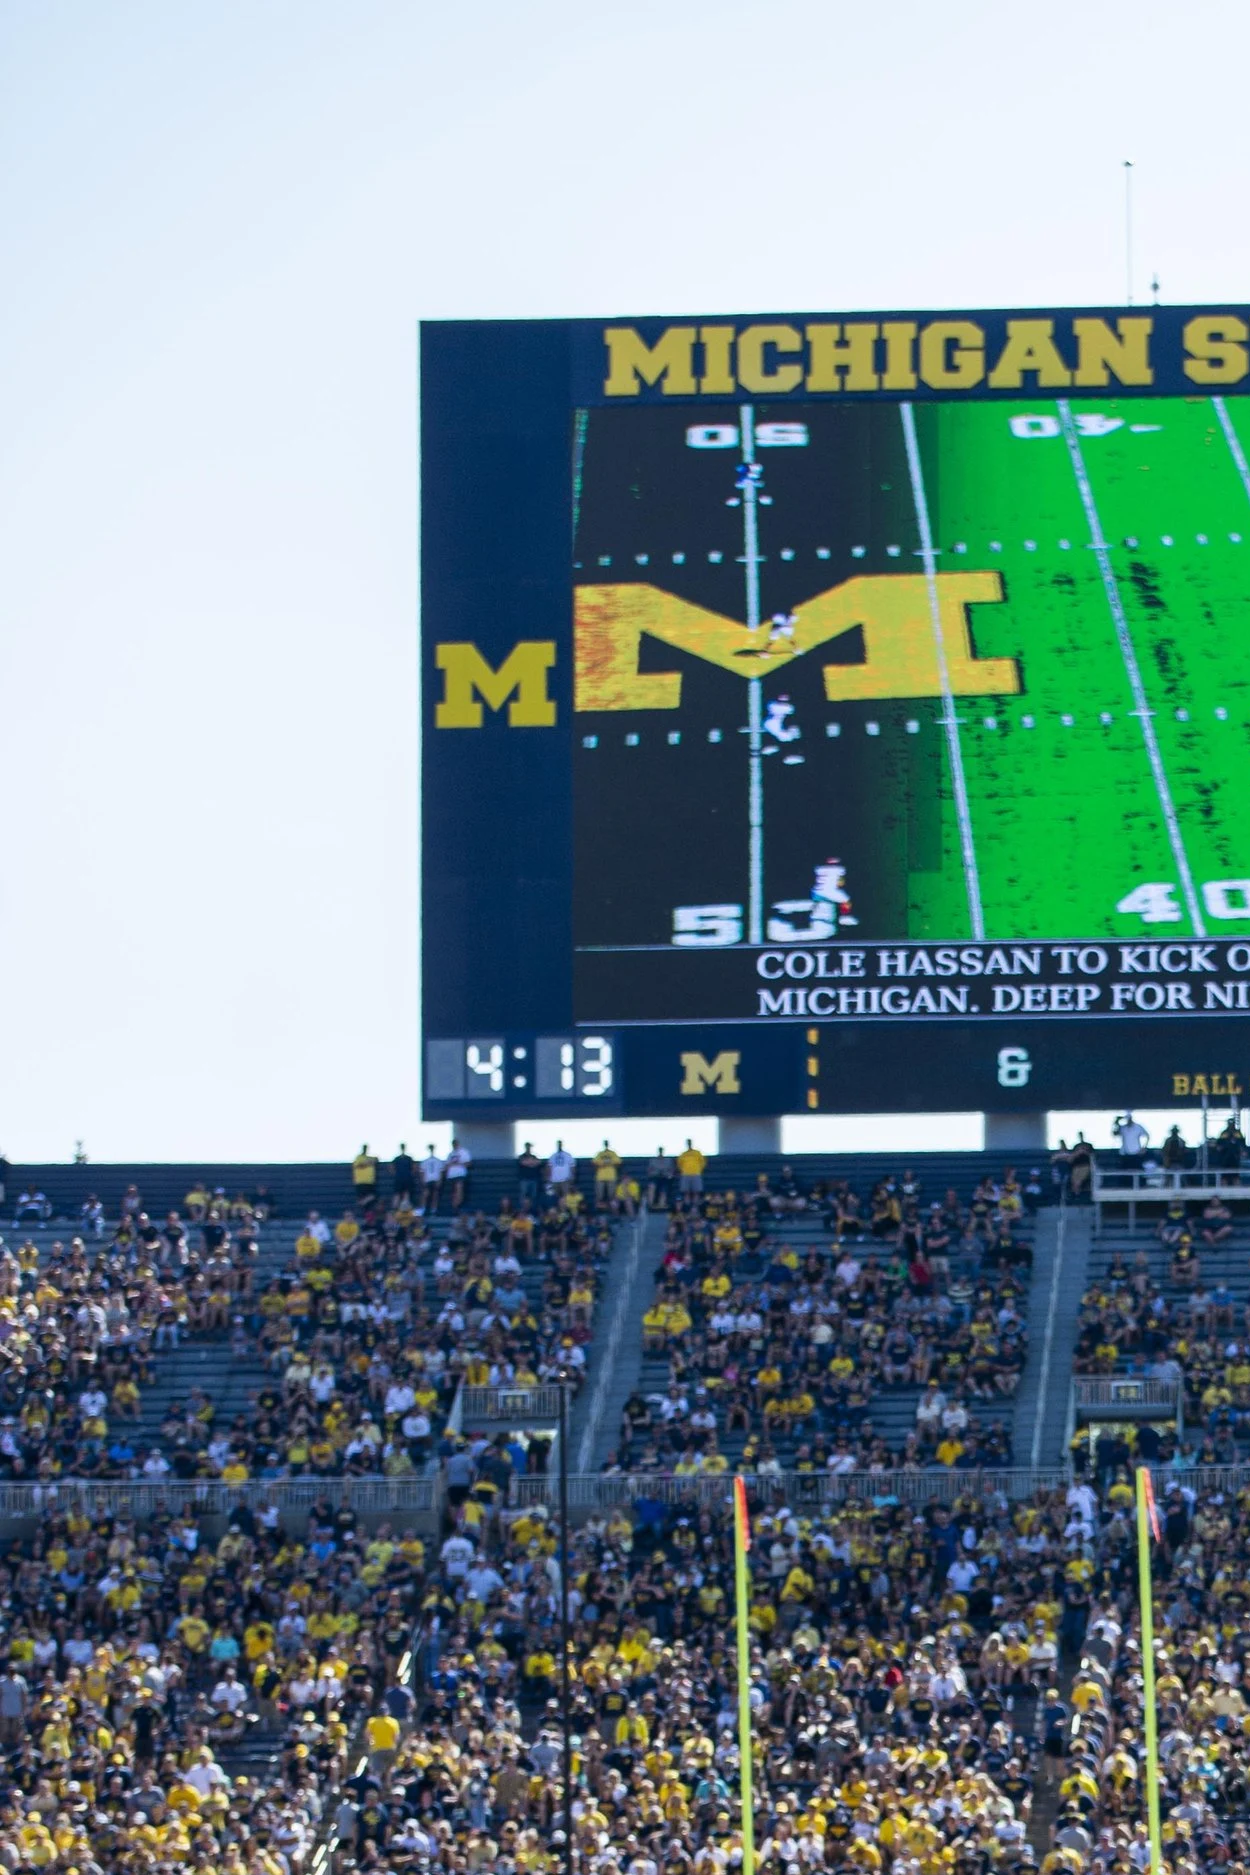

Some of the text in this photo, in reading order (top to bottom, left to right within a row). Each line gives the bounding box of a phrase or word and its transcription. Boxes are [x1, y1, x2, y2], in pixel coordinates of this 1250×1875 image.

[604, 317, 1158, 396] MICHIGAN
[434, 641, 556, 728] M
[756, 950, 867, 979] COLE
[876, 947, 1044, 977] HASSAN
[1051, 946, 1108, 975] TO
[1118, 943, 1218, 974] KICK
[756, 985, 980, 1018] MICHIGAN.
[991, 983, 1101, 1014] DEEP
[1110, 981, 1195, 1012] FOR
[466, 1035, 613, 1096] 4:13
[680, 1051, 740, 1094] M
[1171, 1073, 1239, 1095] BALL
